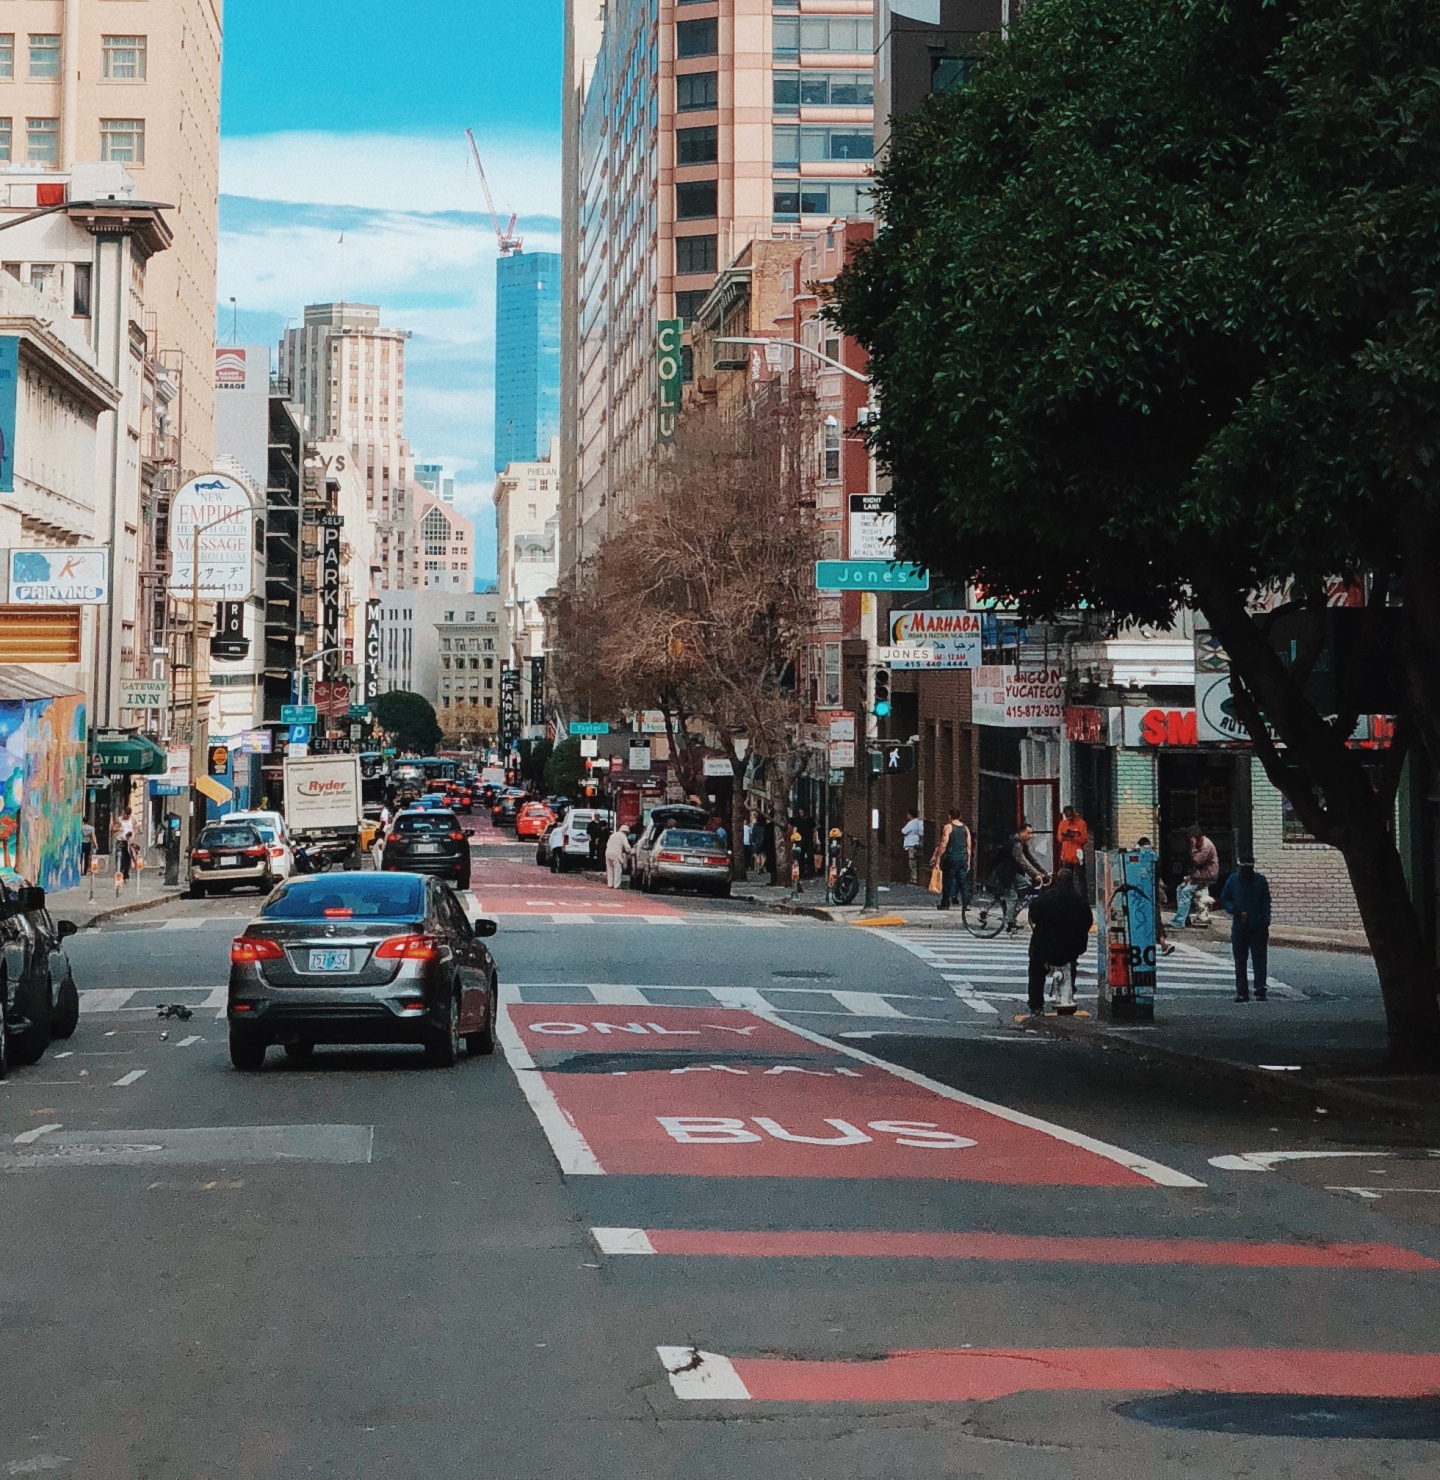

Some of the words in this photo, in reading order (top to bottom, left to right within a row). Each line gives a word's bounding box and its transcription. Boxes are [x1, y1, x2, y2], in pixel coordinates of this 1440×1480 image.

[527, 467, 557, 476] PHELAN
[201, 492, 225, 502] NEW
[179, 504, 246, 525] EMPIRE
[321, 516, 344, 526] SELF
[837, 567, 908, 583] Jones
[910, 612, 980, 632] MARHABA
[367, 605, 379, 698] MACY'S
[883, 649, 930, 659] JONES
[956, 653, 966, 661] AM
[904, 660, 969, 668] 415-440-4444
[121, 682, 166, 691] GATEWAY
[1005, 684, 1062, 699] YUCATECO
[126, 693, 161, 704] INN
[576, 724, 603, 733] Taylor
[308, 780, 347, 793] Ryder
[528, 1022, 760, 1036] ONLY
[655, 1116, 979, 1150] BUS
